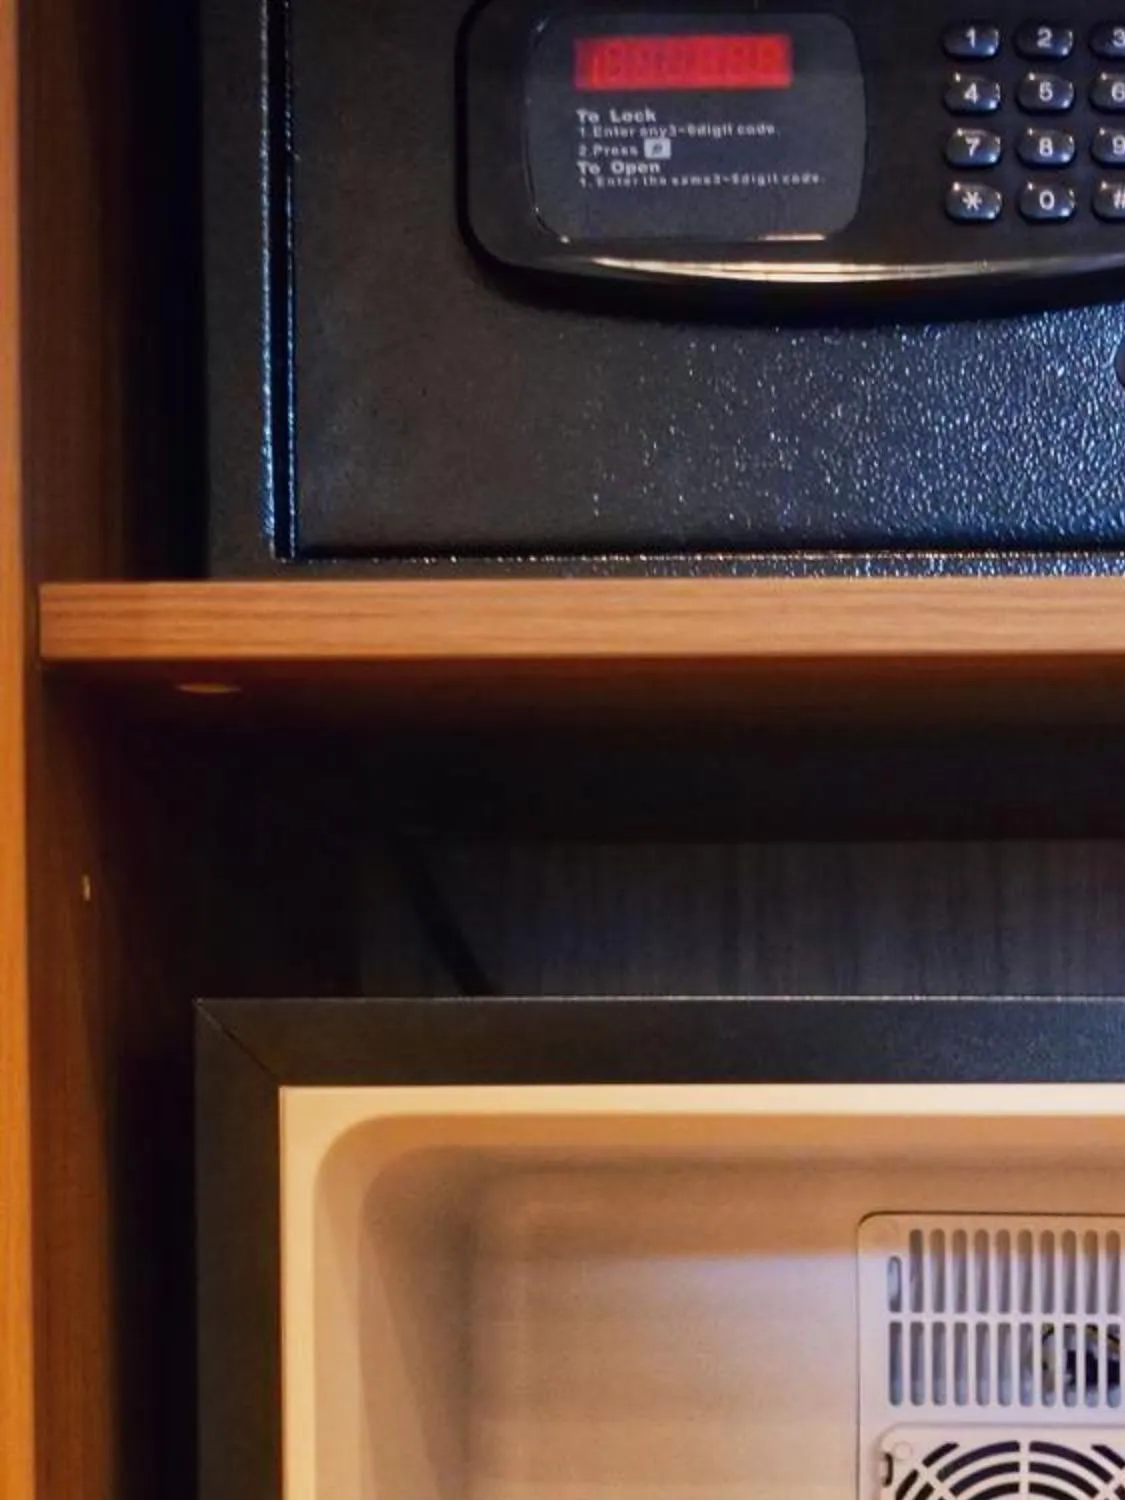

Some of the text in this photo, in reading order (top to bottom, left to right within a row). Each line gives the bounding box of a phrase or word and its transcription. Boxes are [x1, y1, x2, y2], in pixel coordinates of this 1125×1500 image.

[966, 29, 976, 47] 1
[1037, 29, 1052, 47] 2
[964, 83, 1125, 103] 4 5 6
[576, 107, 656, 123] To Lock
[965, 138, 980, 156] 7
[1038, 137, 1053, 156] 8
[576, 161, 660, 177] To Open
[1039, 192, 1055, 210] 0
